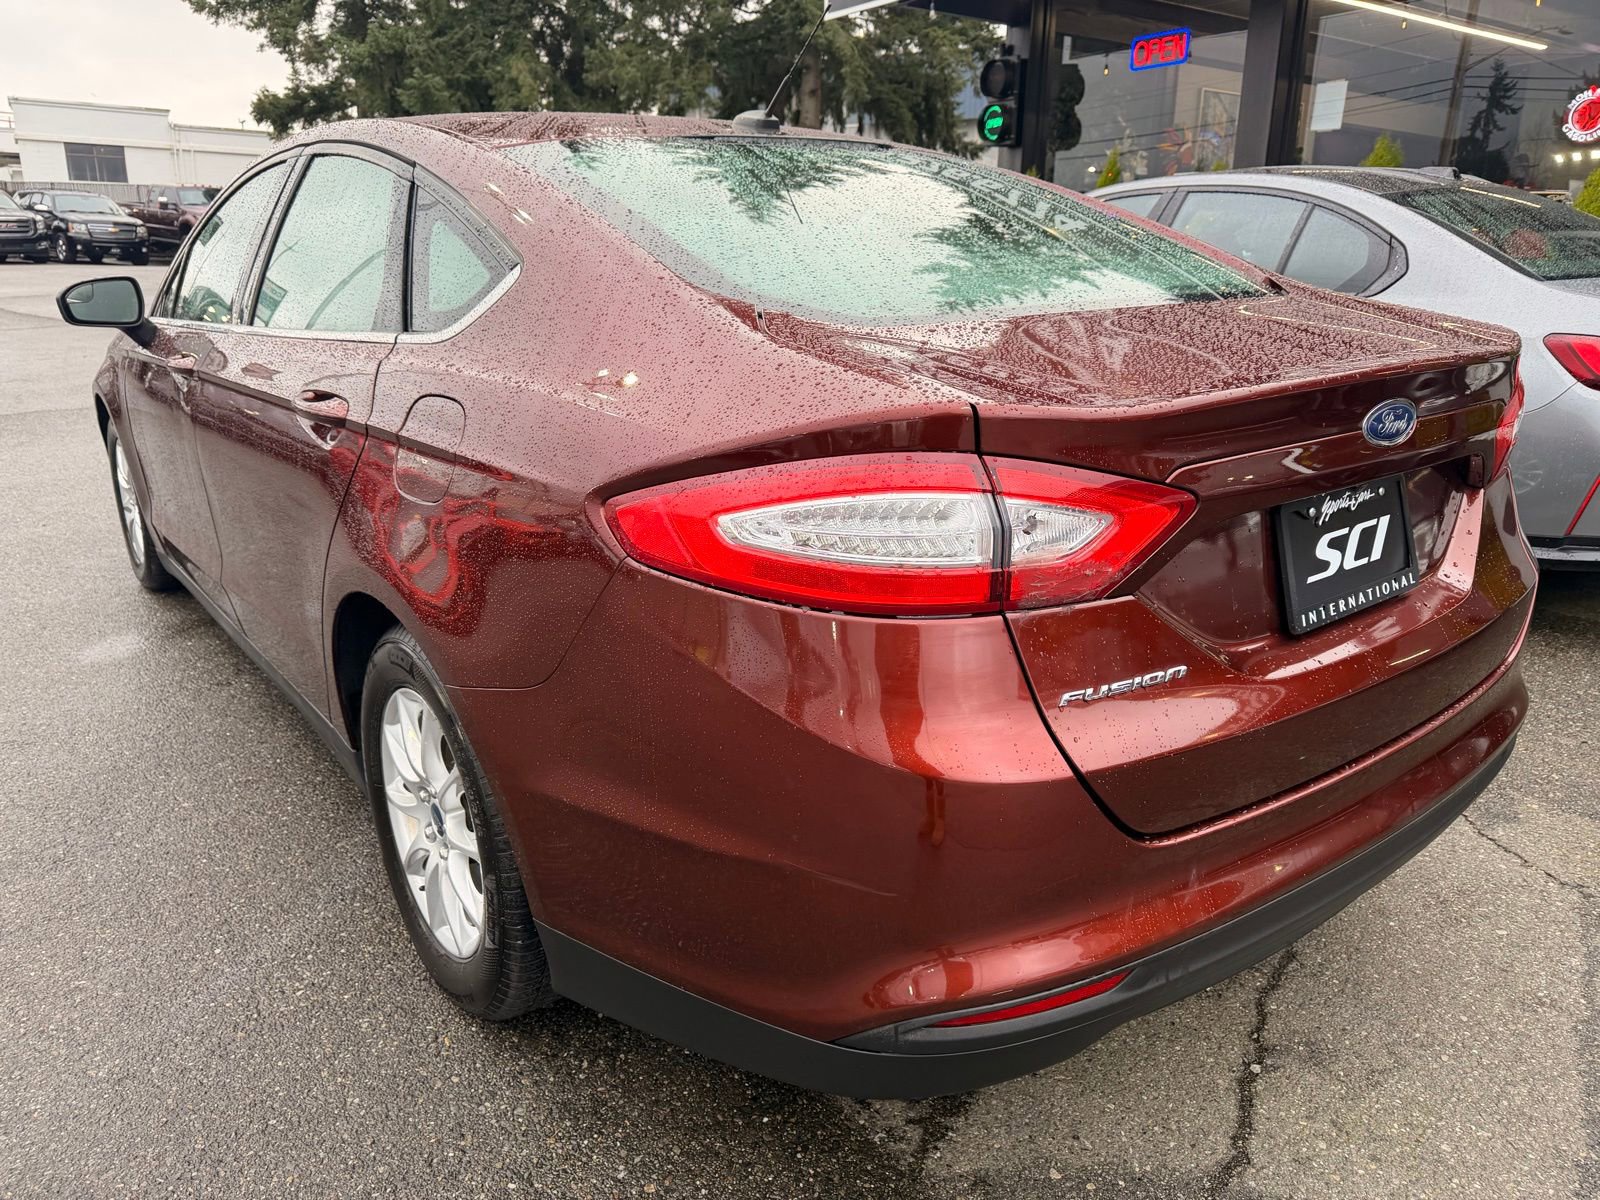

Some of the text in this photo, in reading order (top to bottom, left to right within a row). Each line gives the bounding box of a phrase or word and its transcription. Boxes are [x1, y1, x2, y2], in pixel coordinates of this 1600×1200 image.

[1133, 33, 1187, 67] OPEN
[1378, 409, 1408, 436] Ford
[1306, 514, 1391, 584] SCI
[1301, 572, 1416, 627] INTERNATIONAL
[1058, 665, 1188, 707] FUSION
